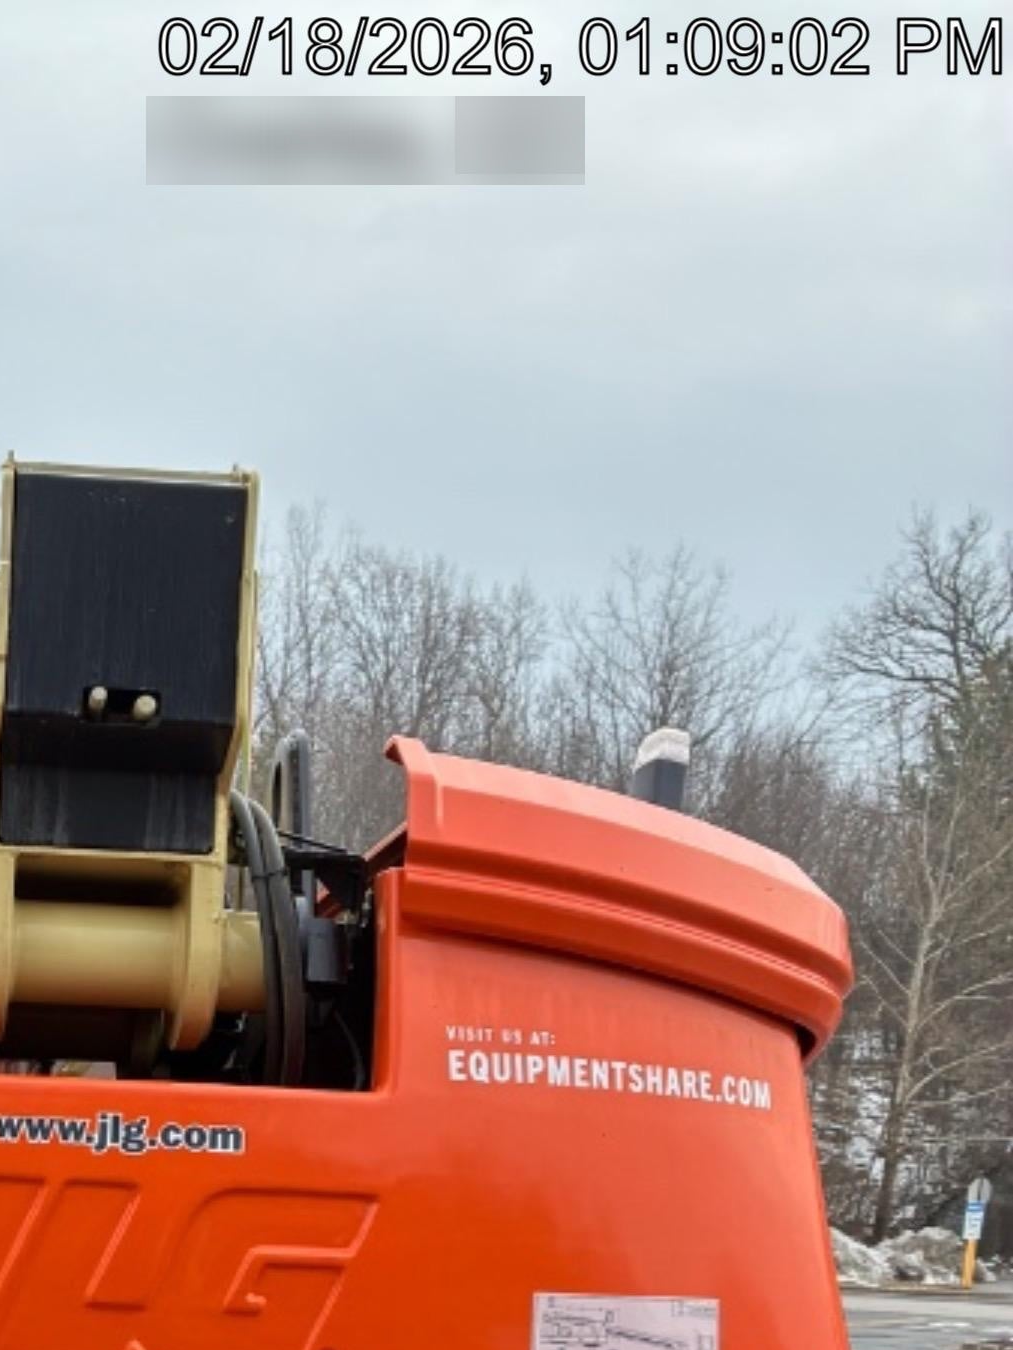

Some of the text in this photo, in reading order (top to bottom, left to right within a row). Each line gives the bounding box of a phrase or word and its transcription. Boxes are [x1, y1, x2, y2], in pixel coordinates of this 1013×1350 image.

[445, 1025, 557, 1046] VISIT US AT:
[447, 1049, 772, 1110] EQUIPMENTSHARE.COM
